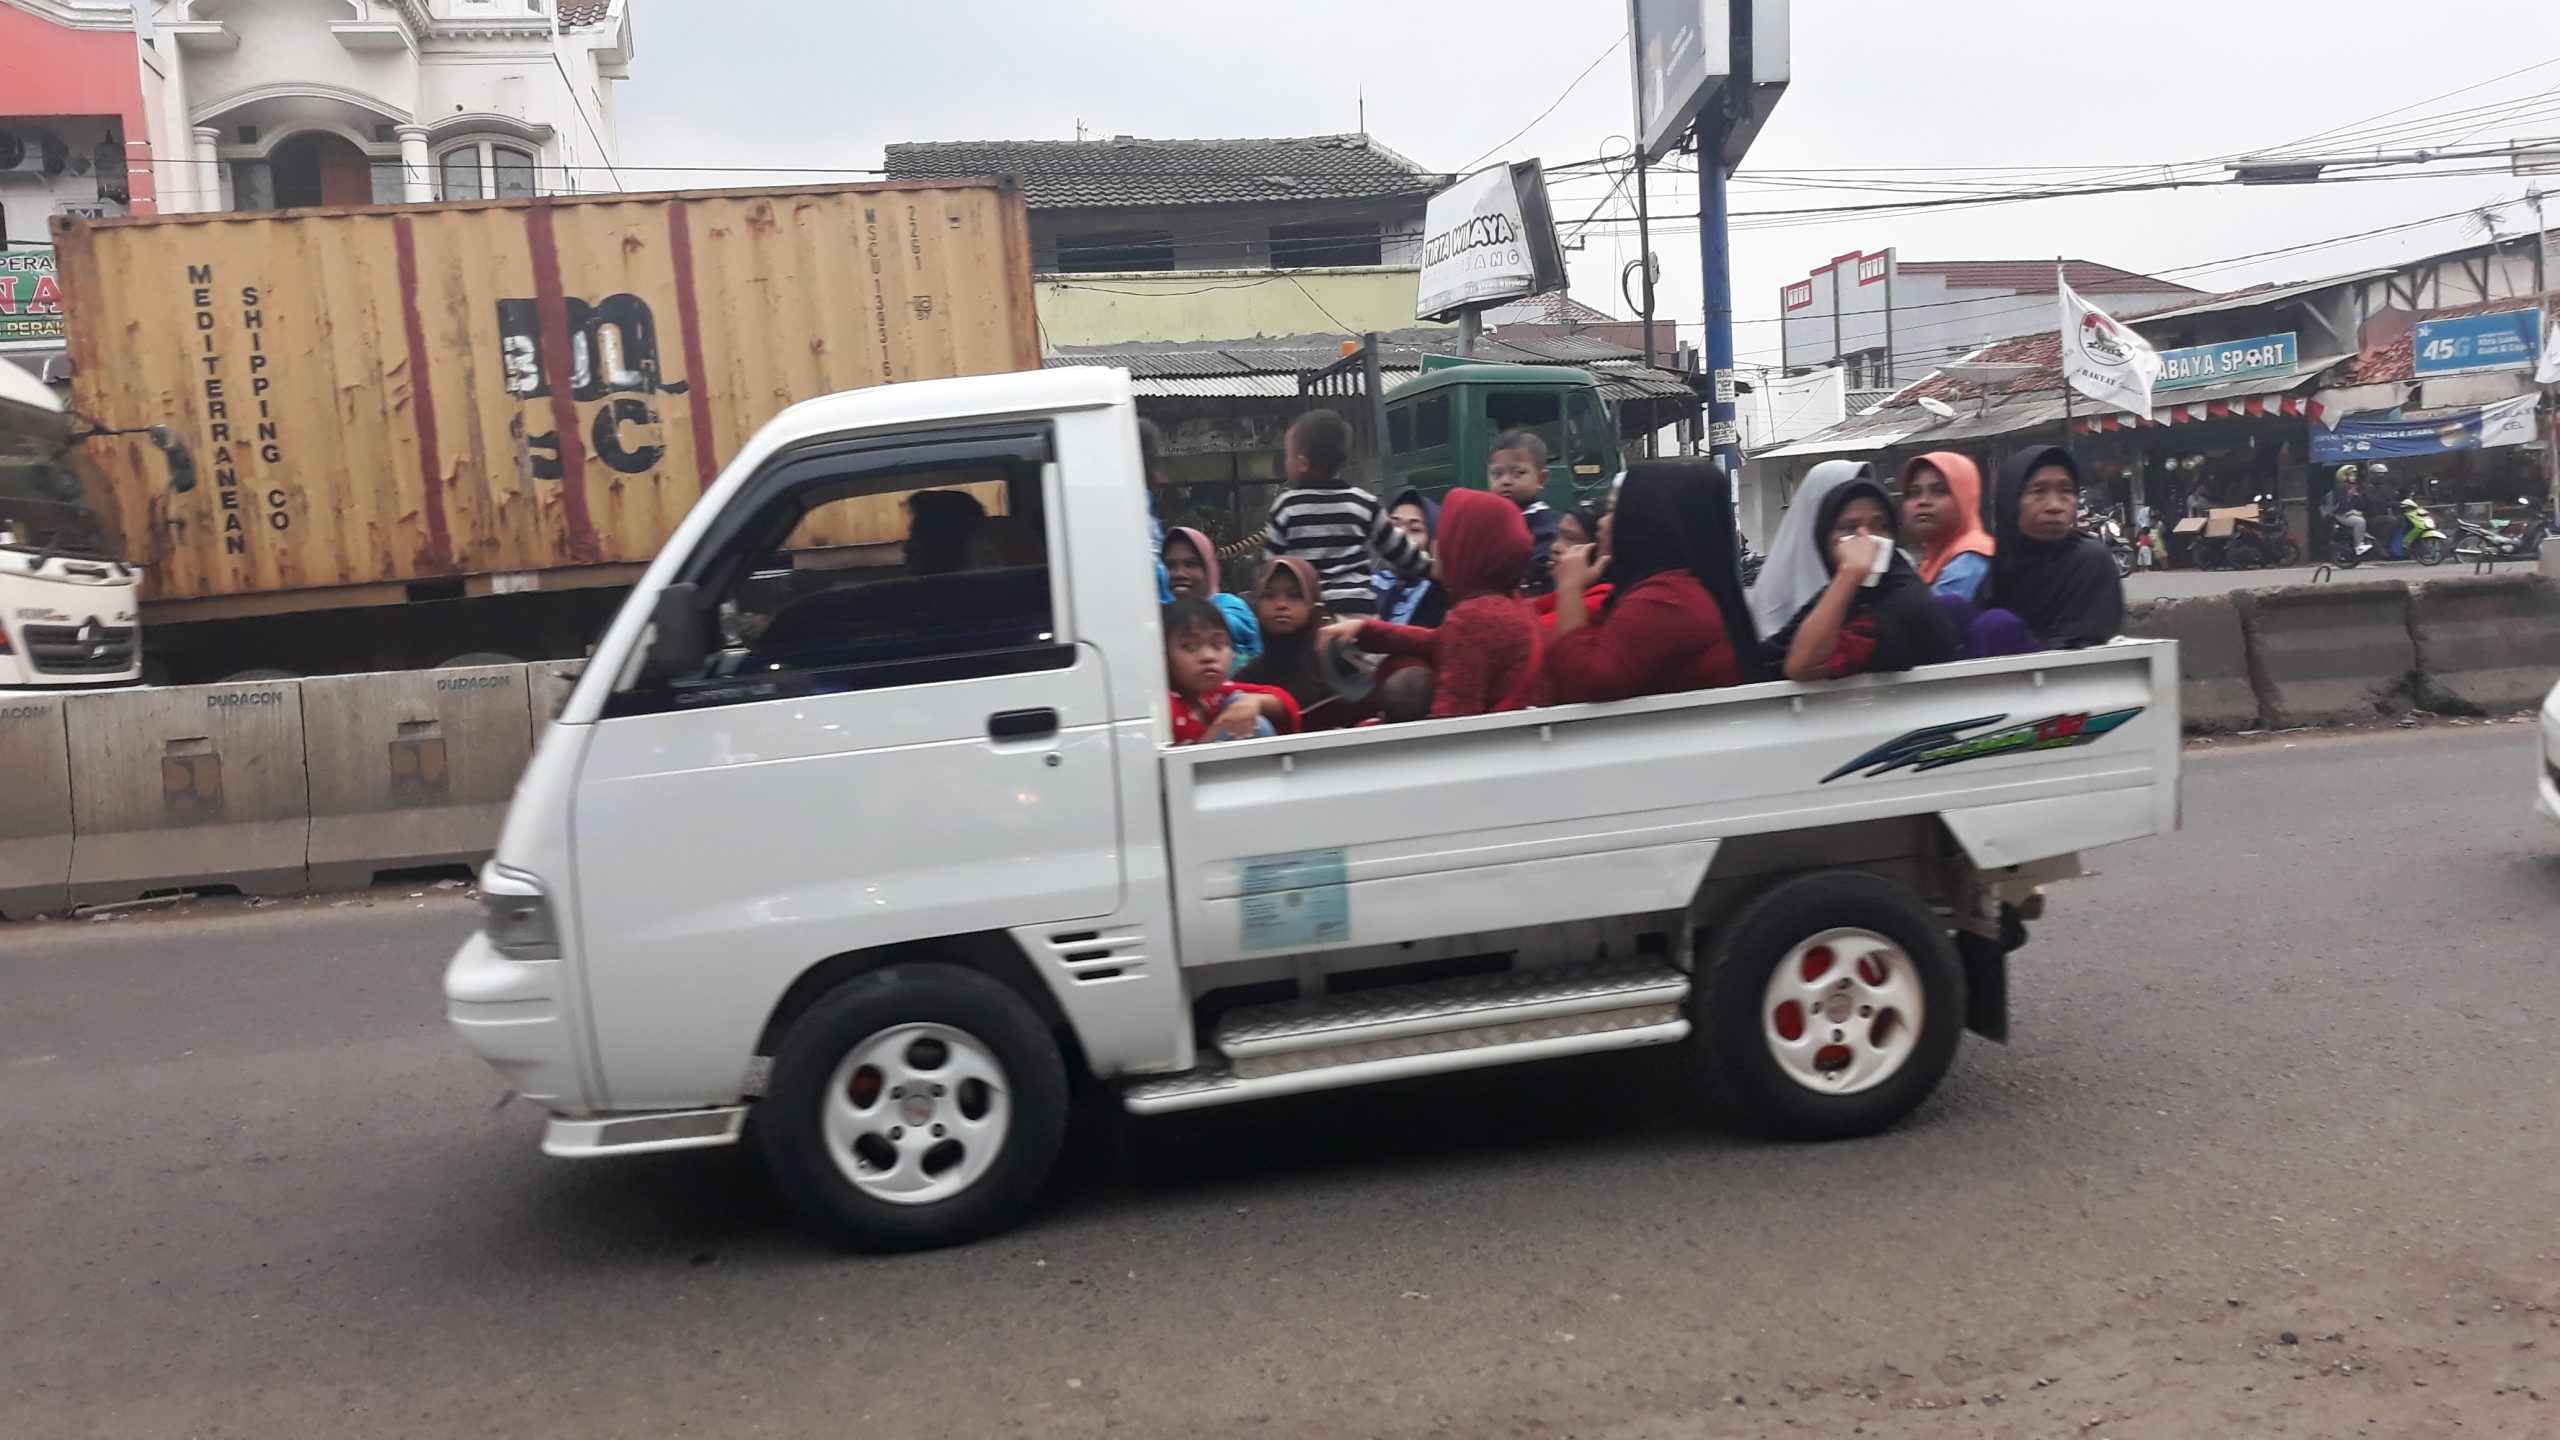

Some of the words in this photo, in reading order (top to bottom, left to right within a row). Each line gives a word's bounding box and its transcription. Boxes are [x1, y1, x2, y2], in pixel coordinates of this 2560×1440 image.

[187, 264, 245, 554] MEDITERRANEAN
[241, 286, 281, 464] SHIPPING
[268, 489, 289, 530] CO
[206, 691, 282, 707] DURACON
[437, 676, 512, 691] DURACON
